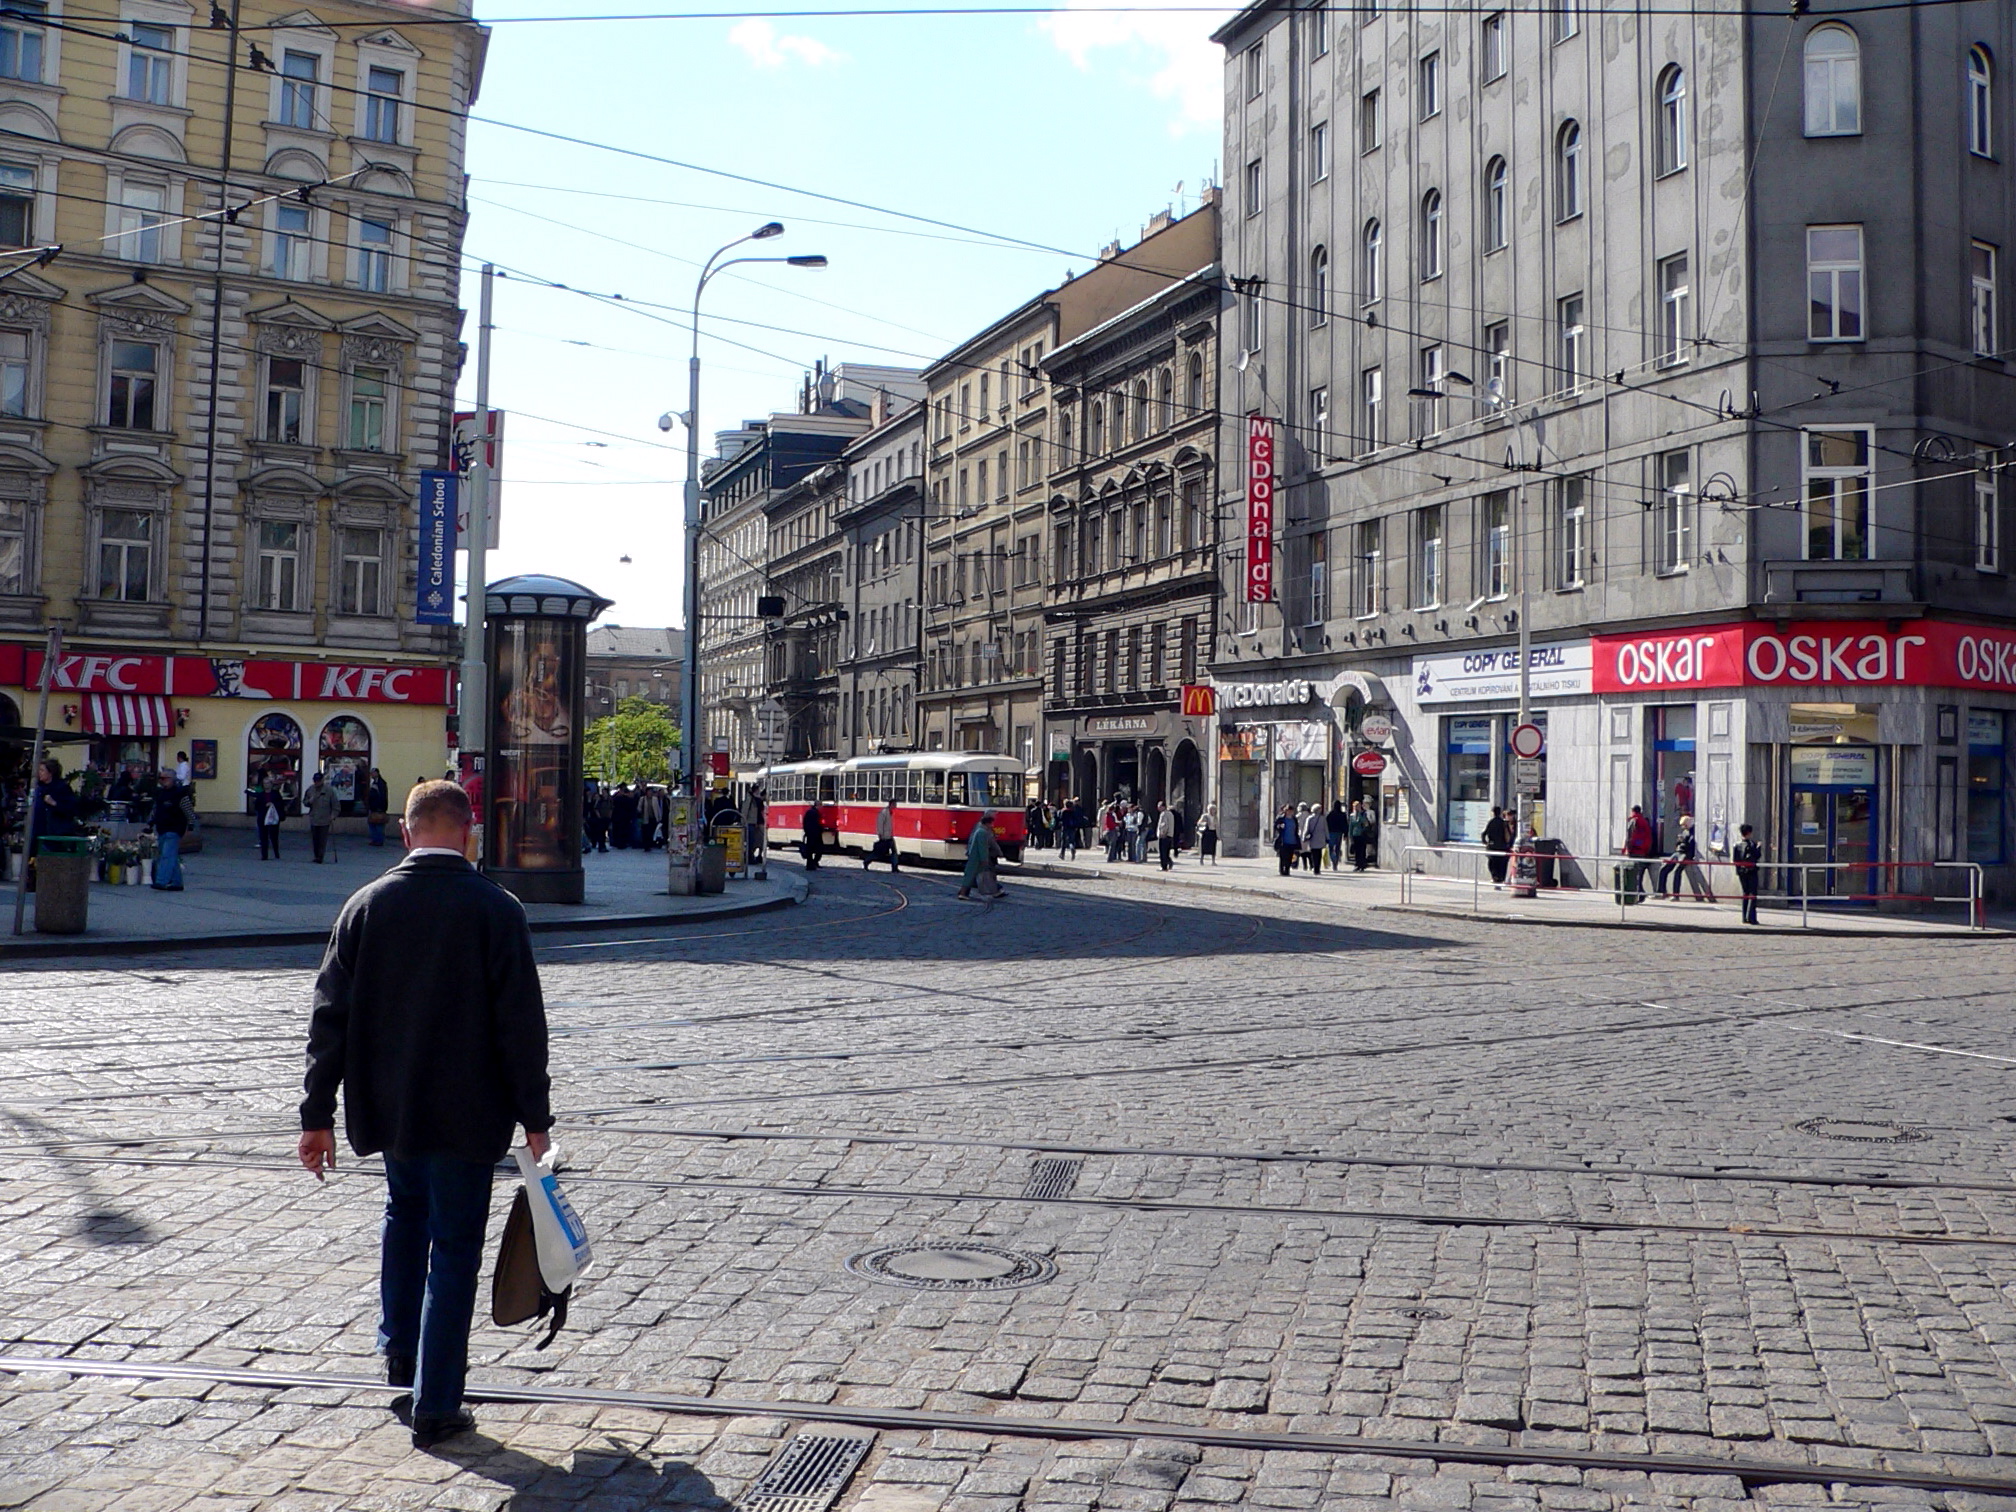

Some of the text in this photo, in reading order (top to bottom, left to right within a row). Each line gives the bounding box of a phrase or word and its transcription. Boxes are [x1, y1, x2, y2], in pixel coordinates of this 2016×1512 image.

[1250, 419, 1274, 601] McDonald's
[430, 478, 446, 586] Caledonian School
[36, 655, 142, 690] KFC
[1463, 647, 1565, 673] COPY GEERAL
[319, 666, 414, 700] KFC
[1450, 686, 1477, 696] CENTRUM
[1561, 679, 1581, 689] TISKU
[1096, 717, 1148, 730] LÉKÁRNA
[1366, 726, 1391, 736] evian
